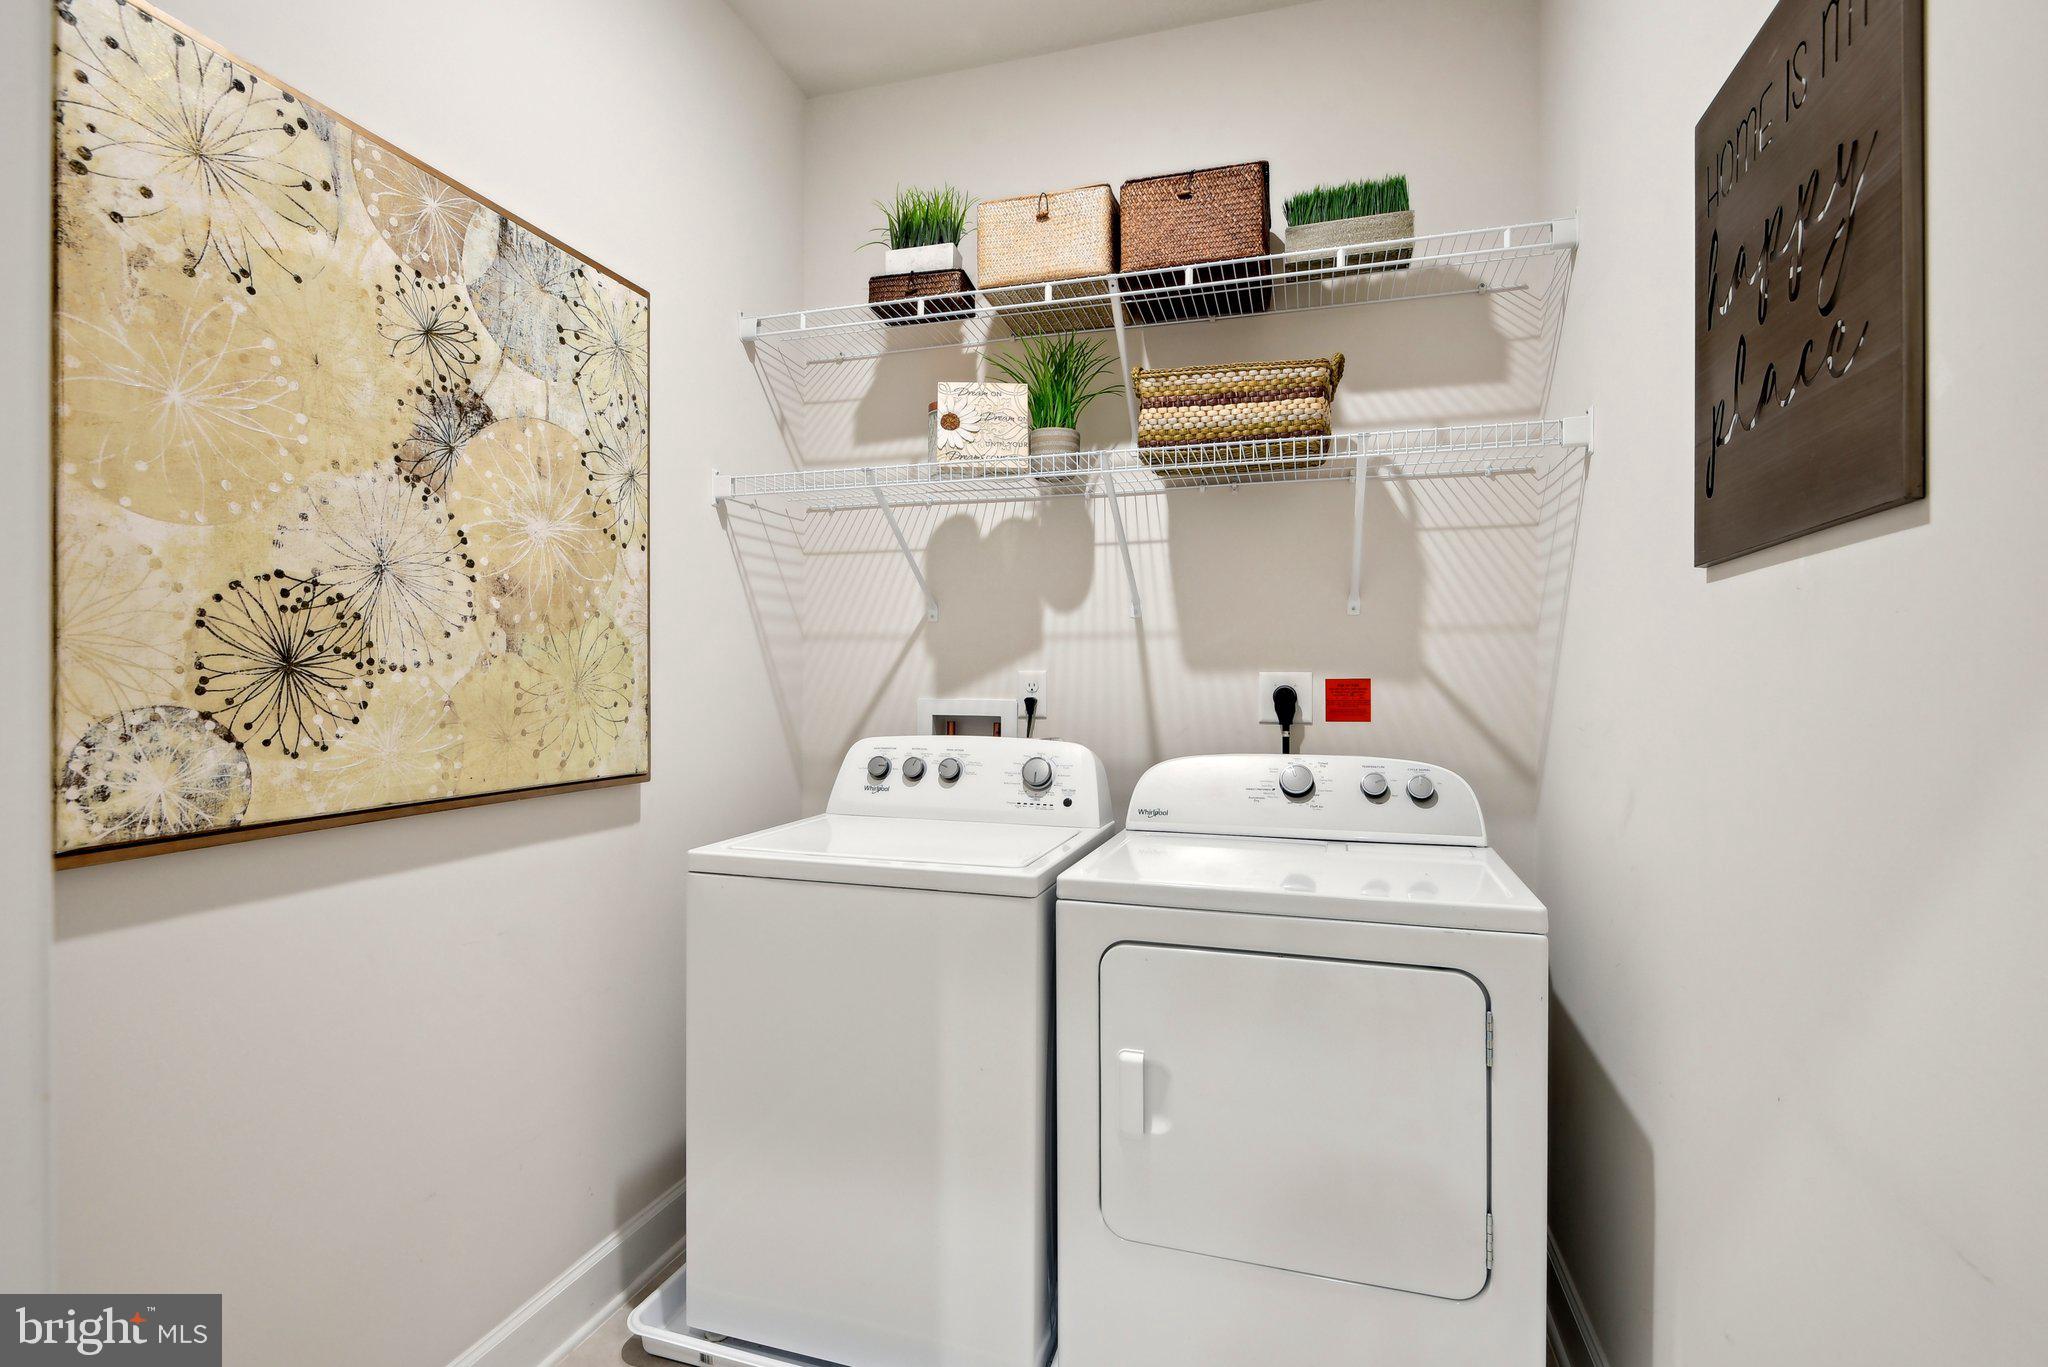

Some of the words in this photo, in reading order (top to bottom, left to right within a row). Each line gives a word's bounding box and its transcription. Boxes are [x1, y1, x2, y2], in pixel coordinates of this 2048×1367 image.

[1706, 80, 1774, 219] HOME
[1785, 40, 1808, 123] IS
[1706, 129, 1879, 332] happy
[954, 387, 988, 397] Dream
[1706, 318, 1869, 499] place
[979, 411, 1015, 421] Dream
[864, 784, 891, 795] Whirlpool
[1137, 808, 1169, 819] Whirlpool
